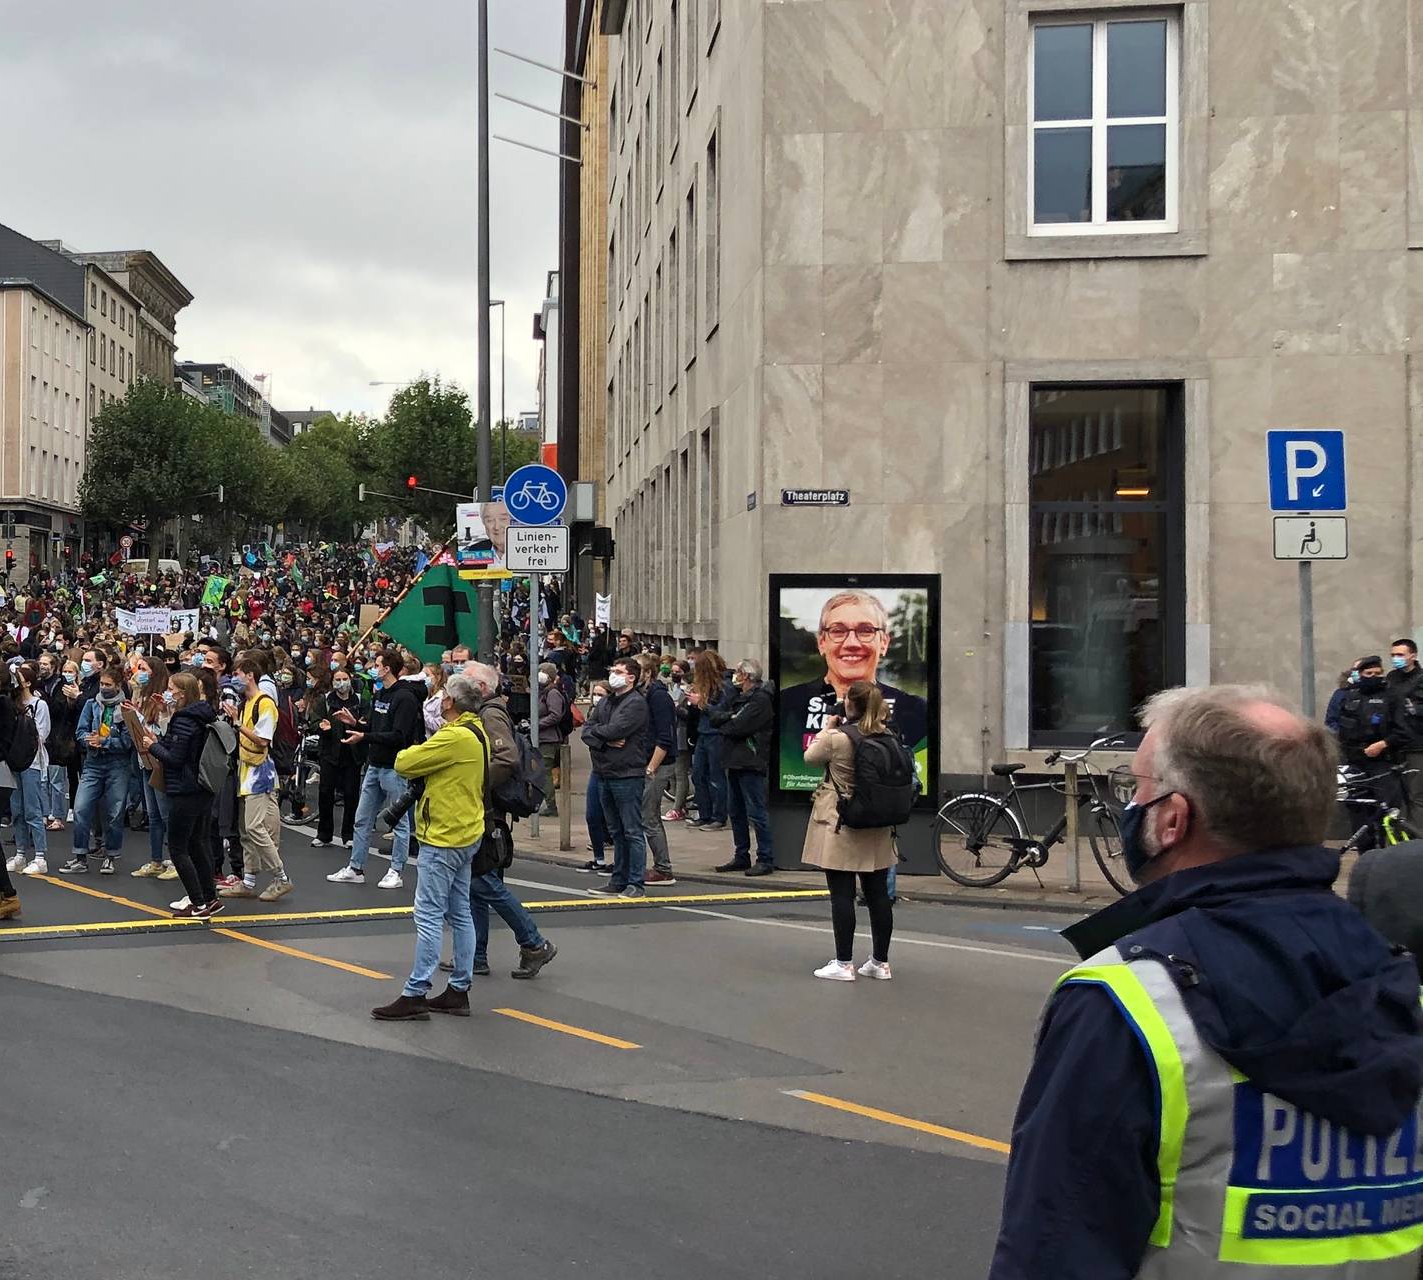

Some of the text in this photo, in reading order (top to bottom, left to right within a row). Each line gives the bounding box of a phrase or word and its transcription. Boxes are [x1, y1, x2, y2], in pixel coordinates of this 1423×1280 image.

[1285, 440, 1327, 501] P
[786, 491, 845, 502] Theaterplatz
[516, 532, 557, 542] Linien-
[515, 543, 559, 554] verkehr
[528, 556, 547, 566] frei
[1253, 1201, 1373, 1232] SOCIAL
